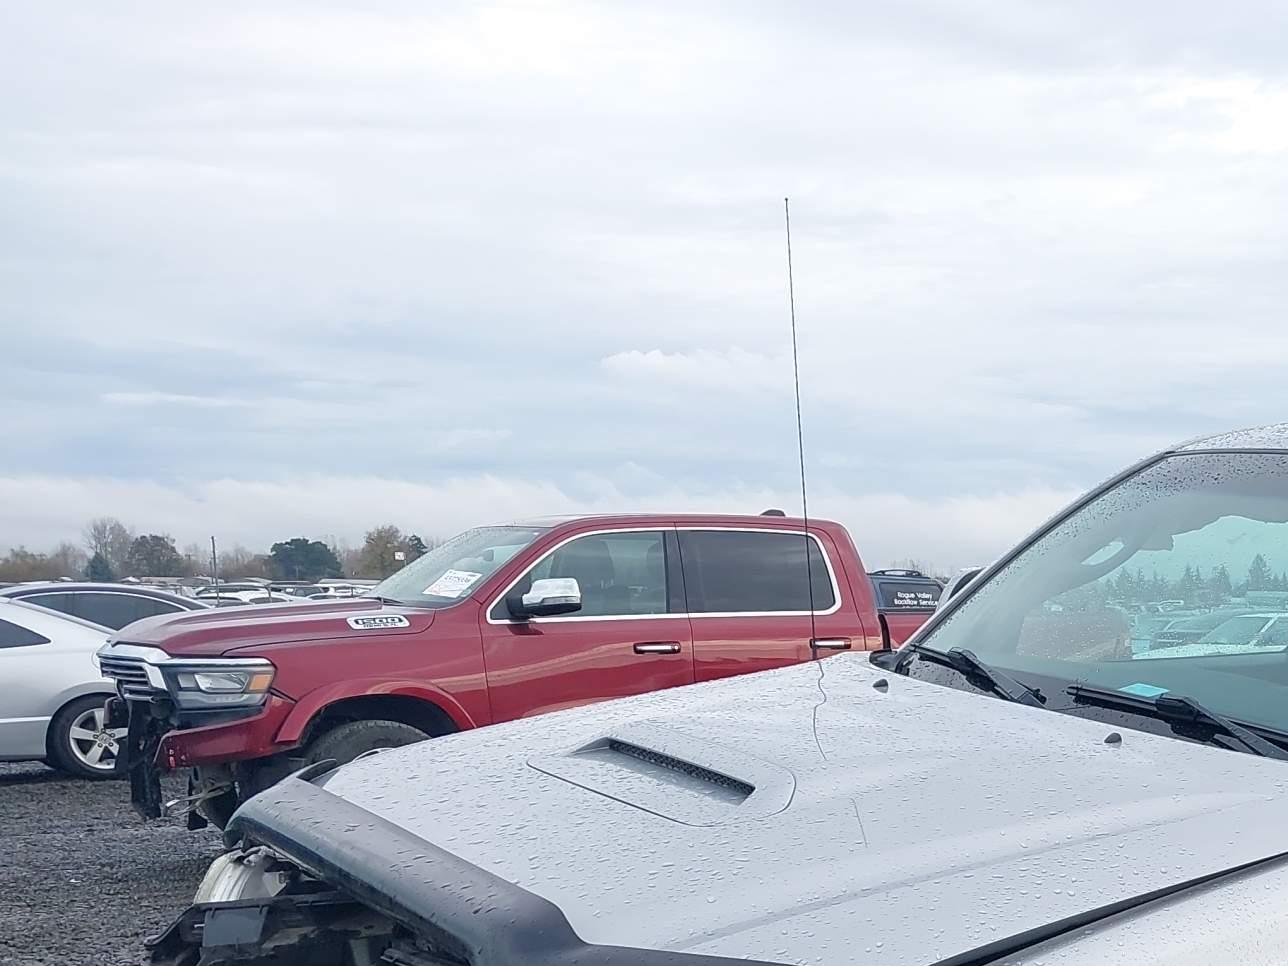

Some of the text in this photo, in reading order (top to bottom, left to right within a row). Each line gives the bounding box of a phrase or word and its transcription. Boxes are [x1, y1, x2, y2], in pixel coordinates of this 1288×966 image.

[897, 591, 932, 601] Rogue Valley
[354, 617, 403, 625] 1500
